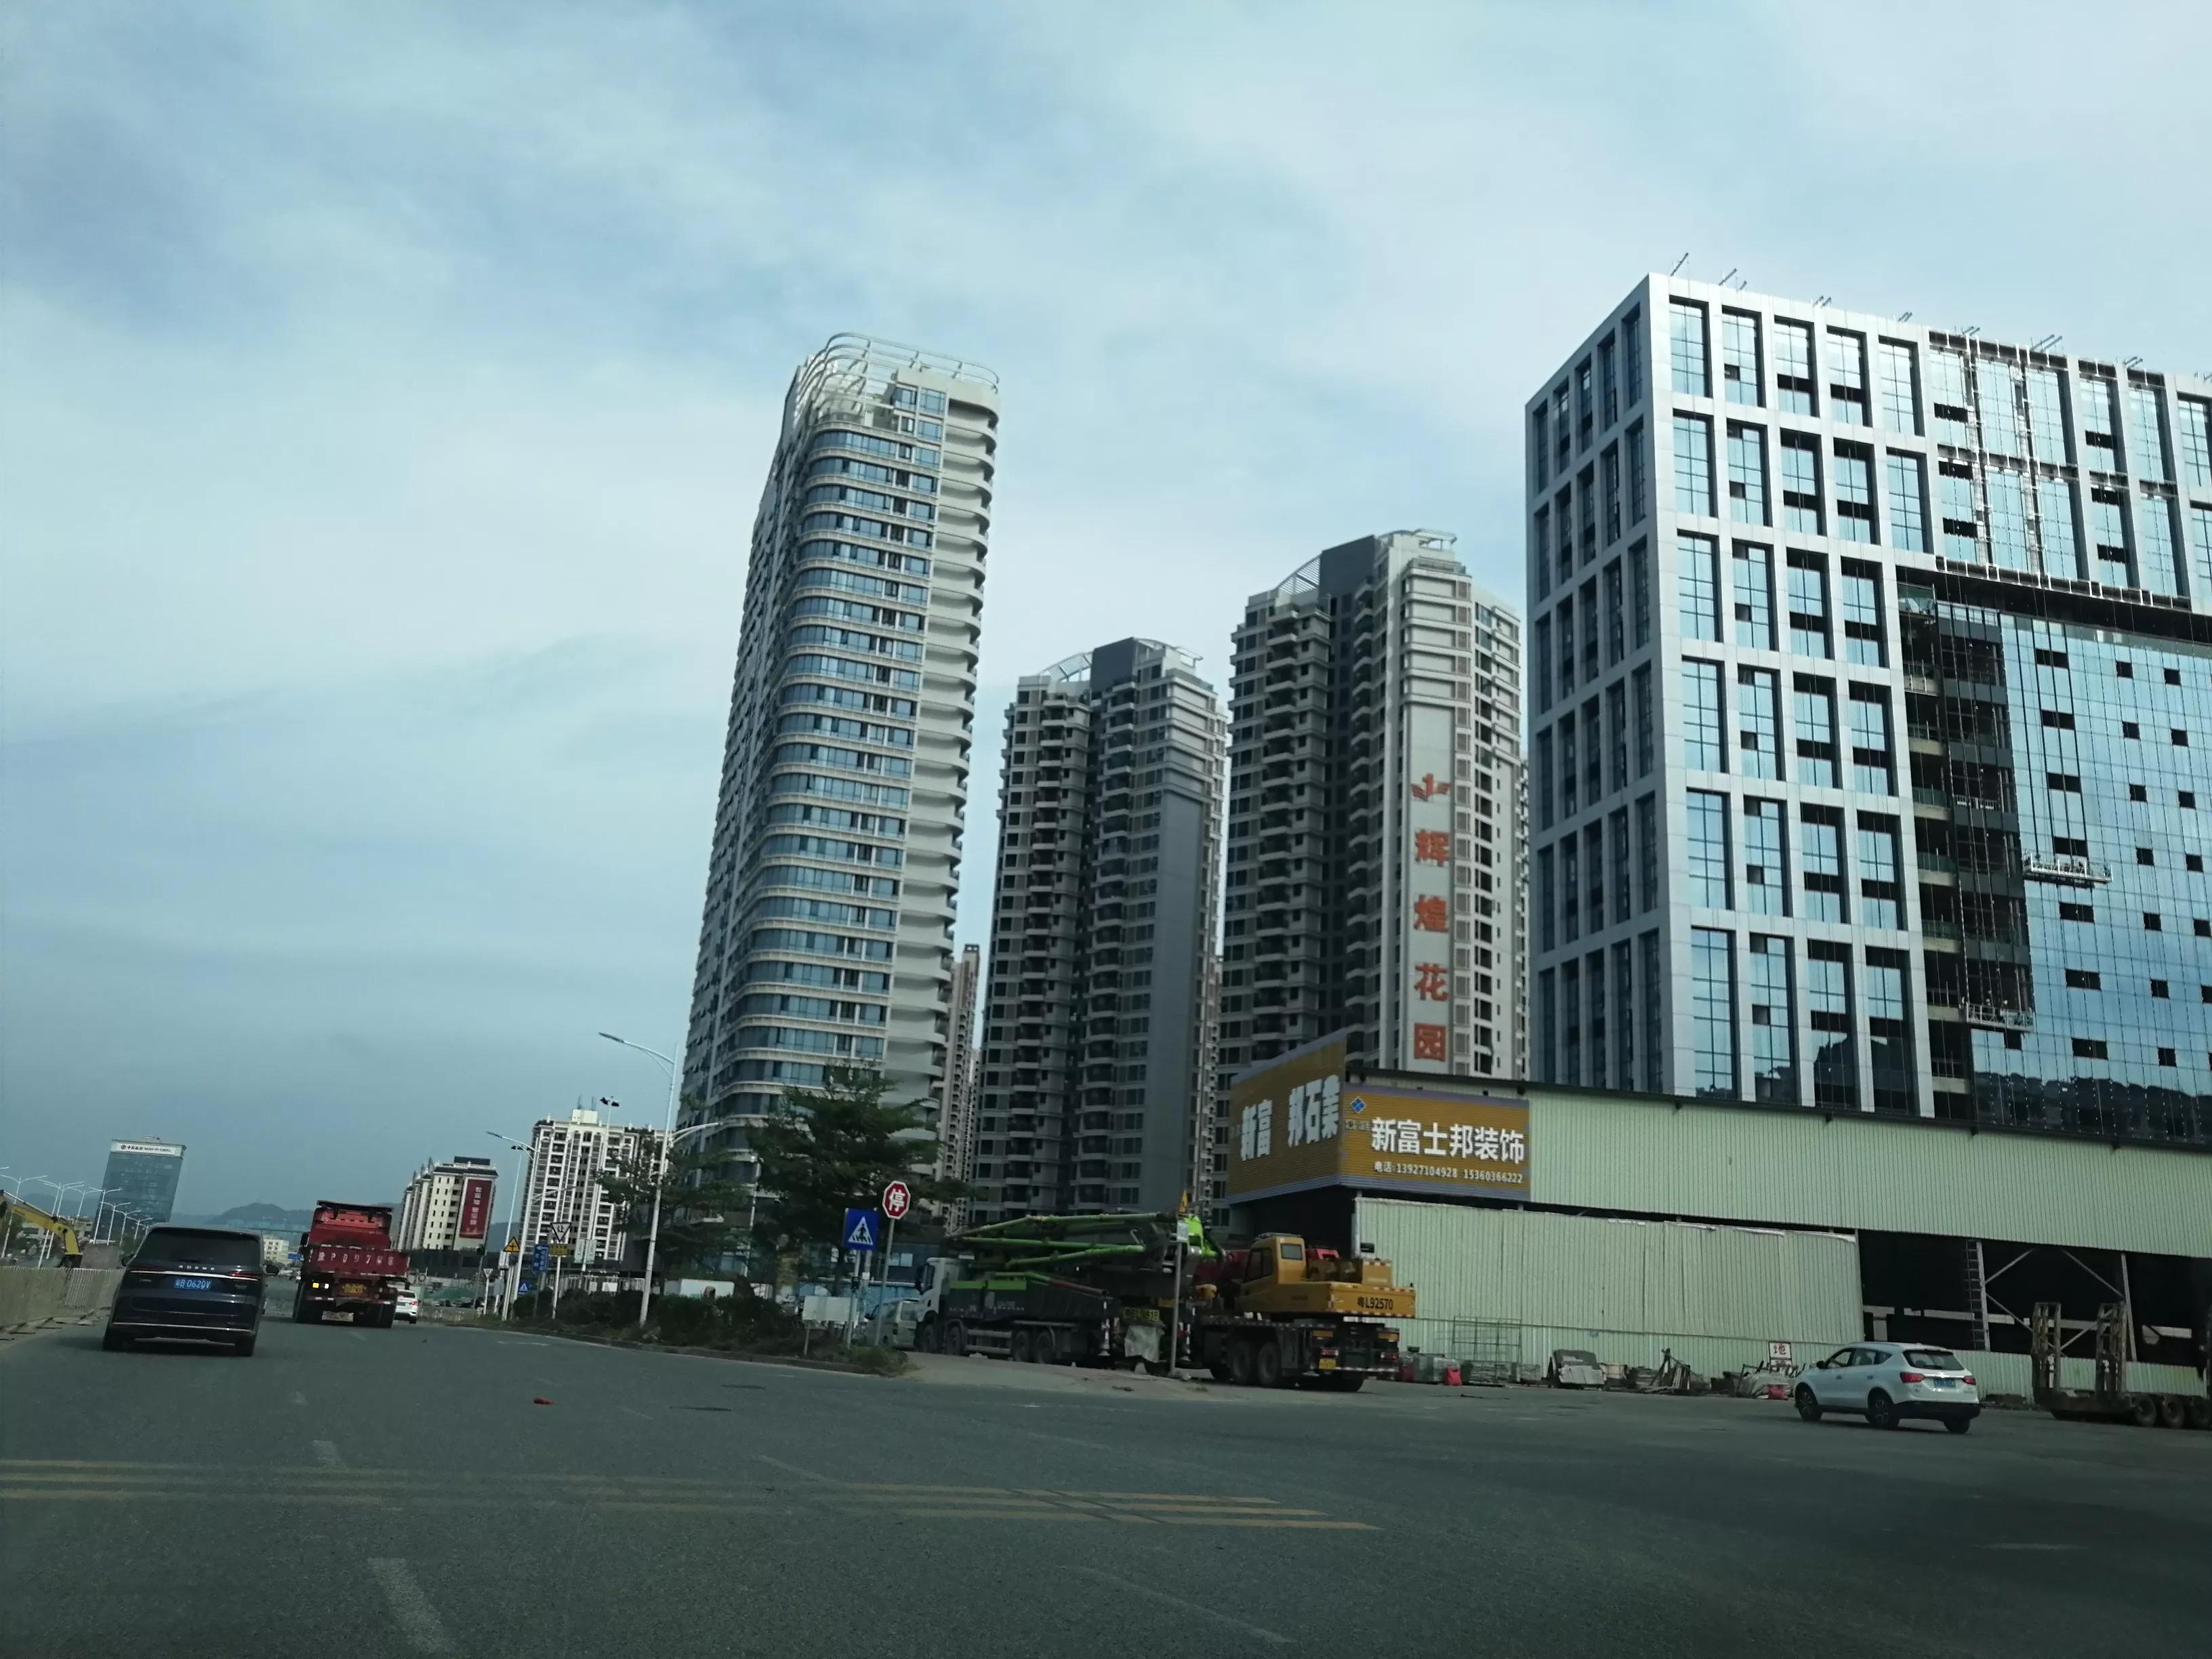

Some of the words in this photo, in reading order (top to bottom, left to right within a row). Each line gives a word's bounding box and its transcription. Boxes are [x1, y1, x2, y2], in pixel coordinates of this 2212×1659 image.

[1413, 829, 1450, 1062] 辉煌花园
[1372, 1117, 1525, 1164] 新富士邦装饰
[888, 1188, 906, 1212] 停
